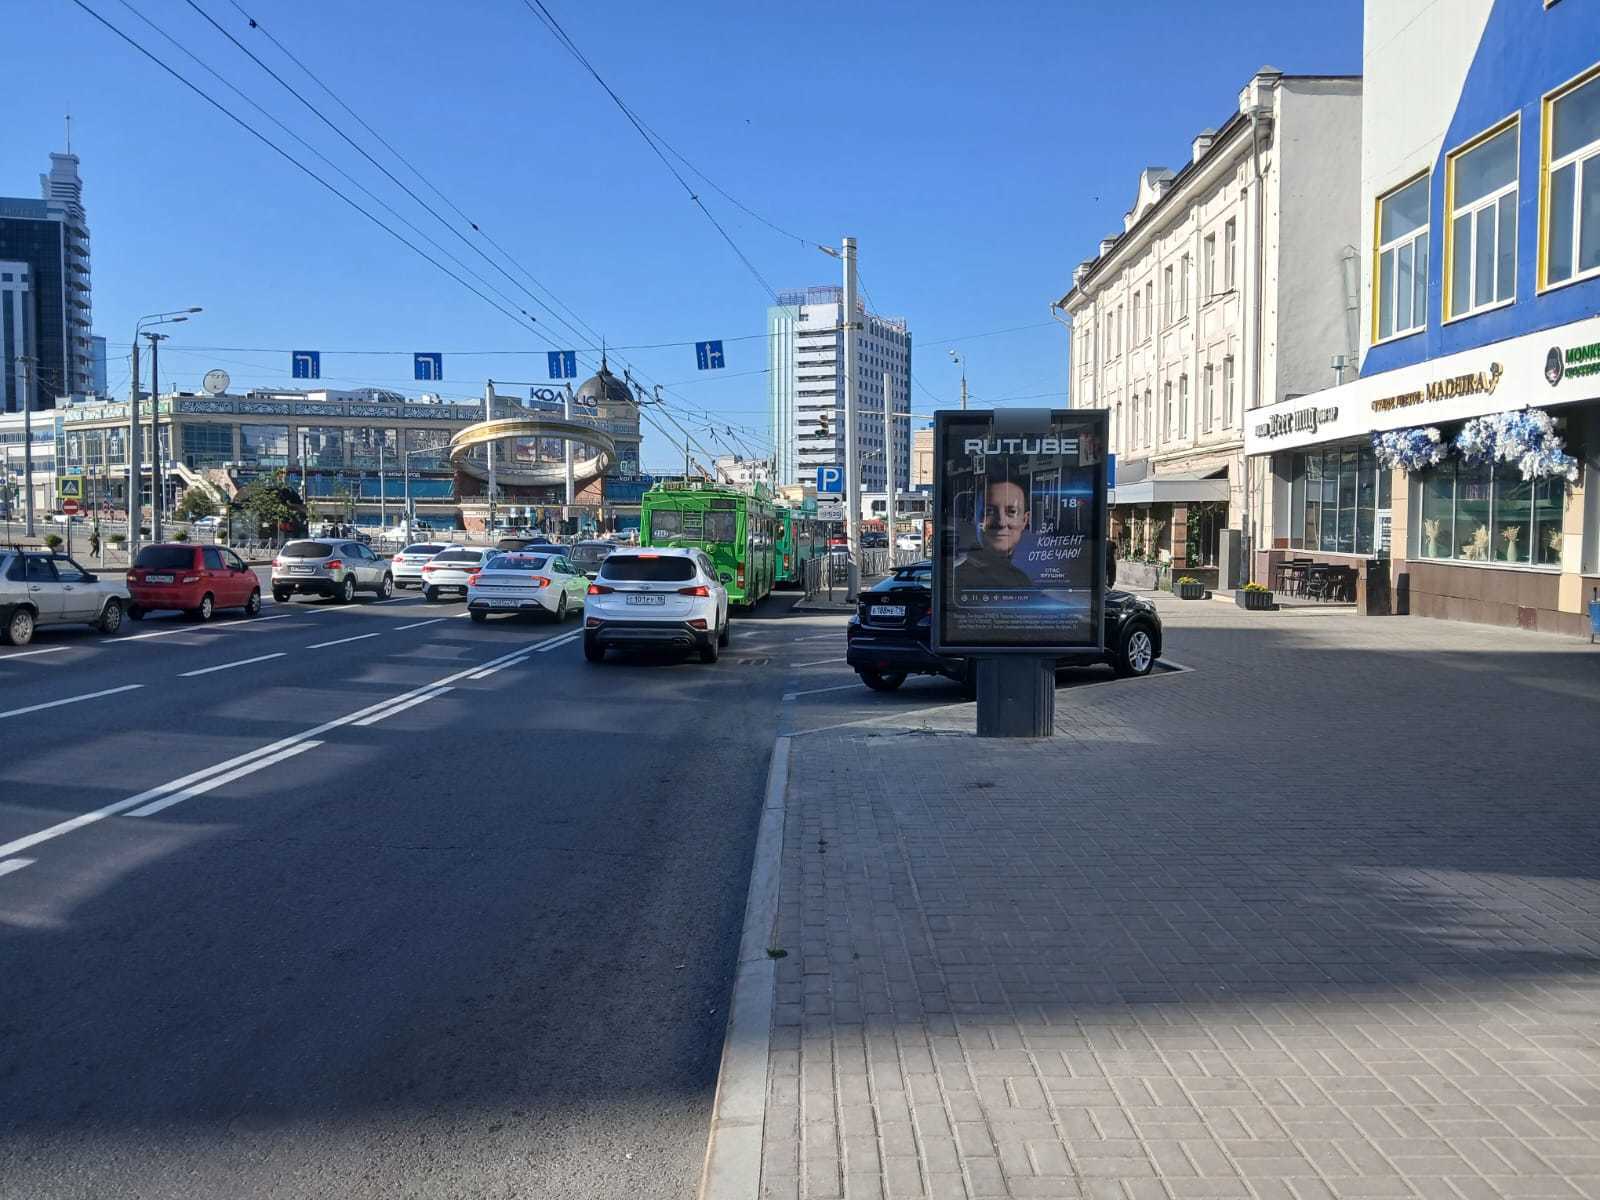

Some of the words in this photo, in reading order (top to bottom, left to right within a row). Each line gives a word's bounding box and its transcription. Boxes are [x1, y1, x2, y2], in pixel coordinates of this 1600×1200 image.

[530, 387, 598, 408] КОЛЦО
[964, 438, 1079, 455] RUTUBE
[1040, 522, 1054, 533] ЗА
[1037, 534, 1085, 547] КОНТЕНТ
[1028, 548, 1082, 561] ОТВЕЧАЮ!
